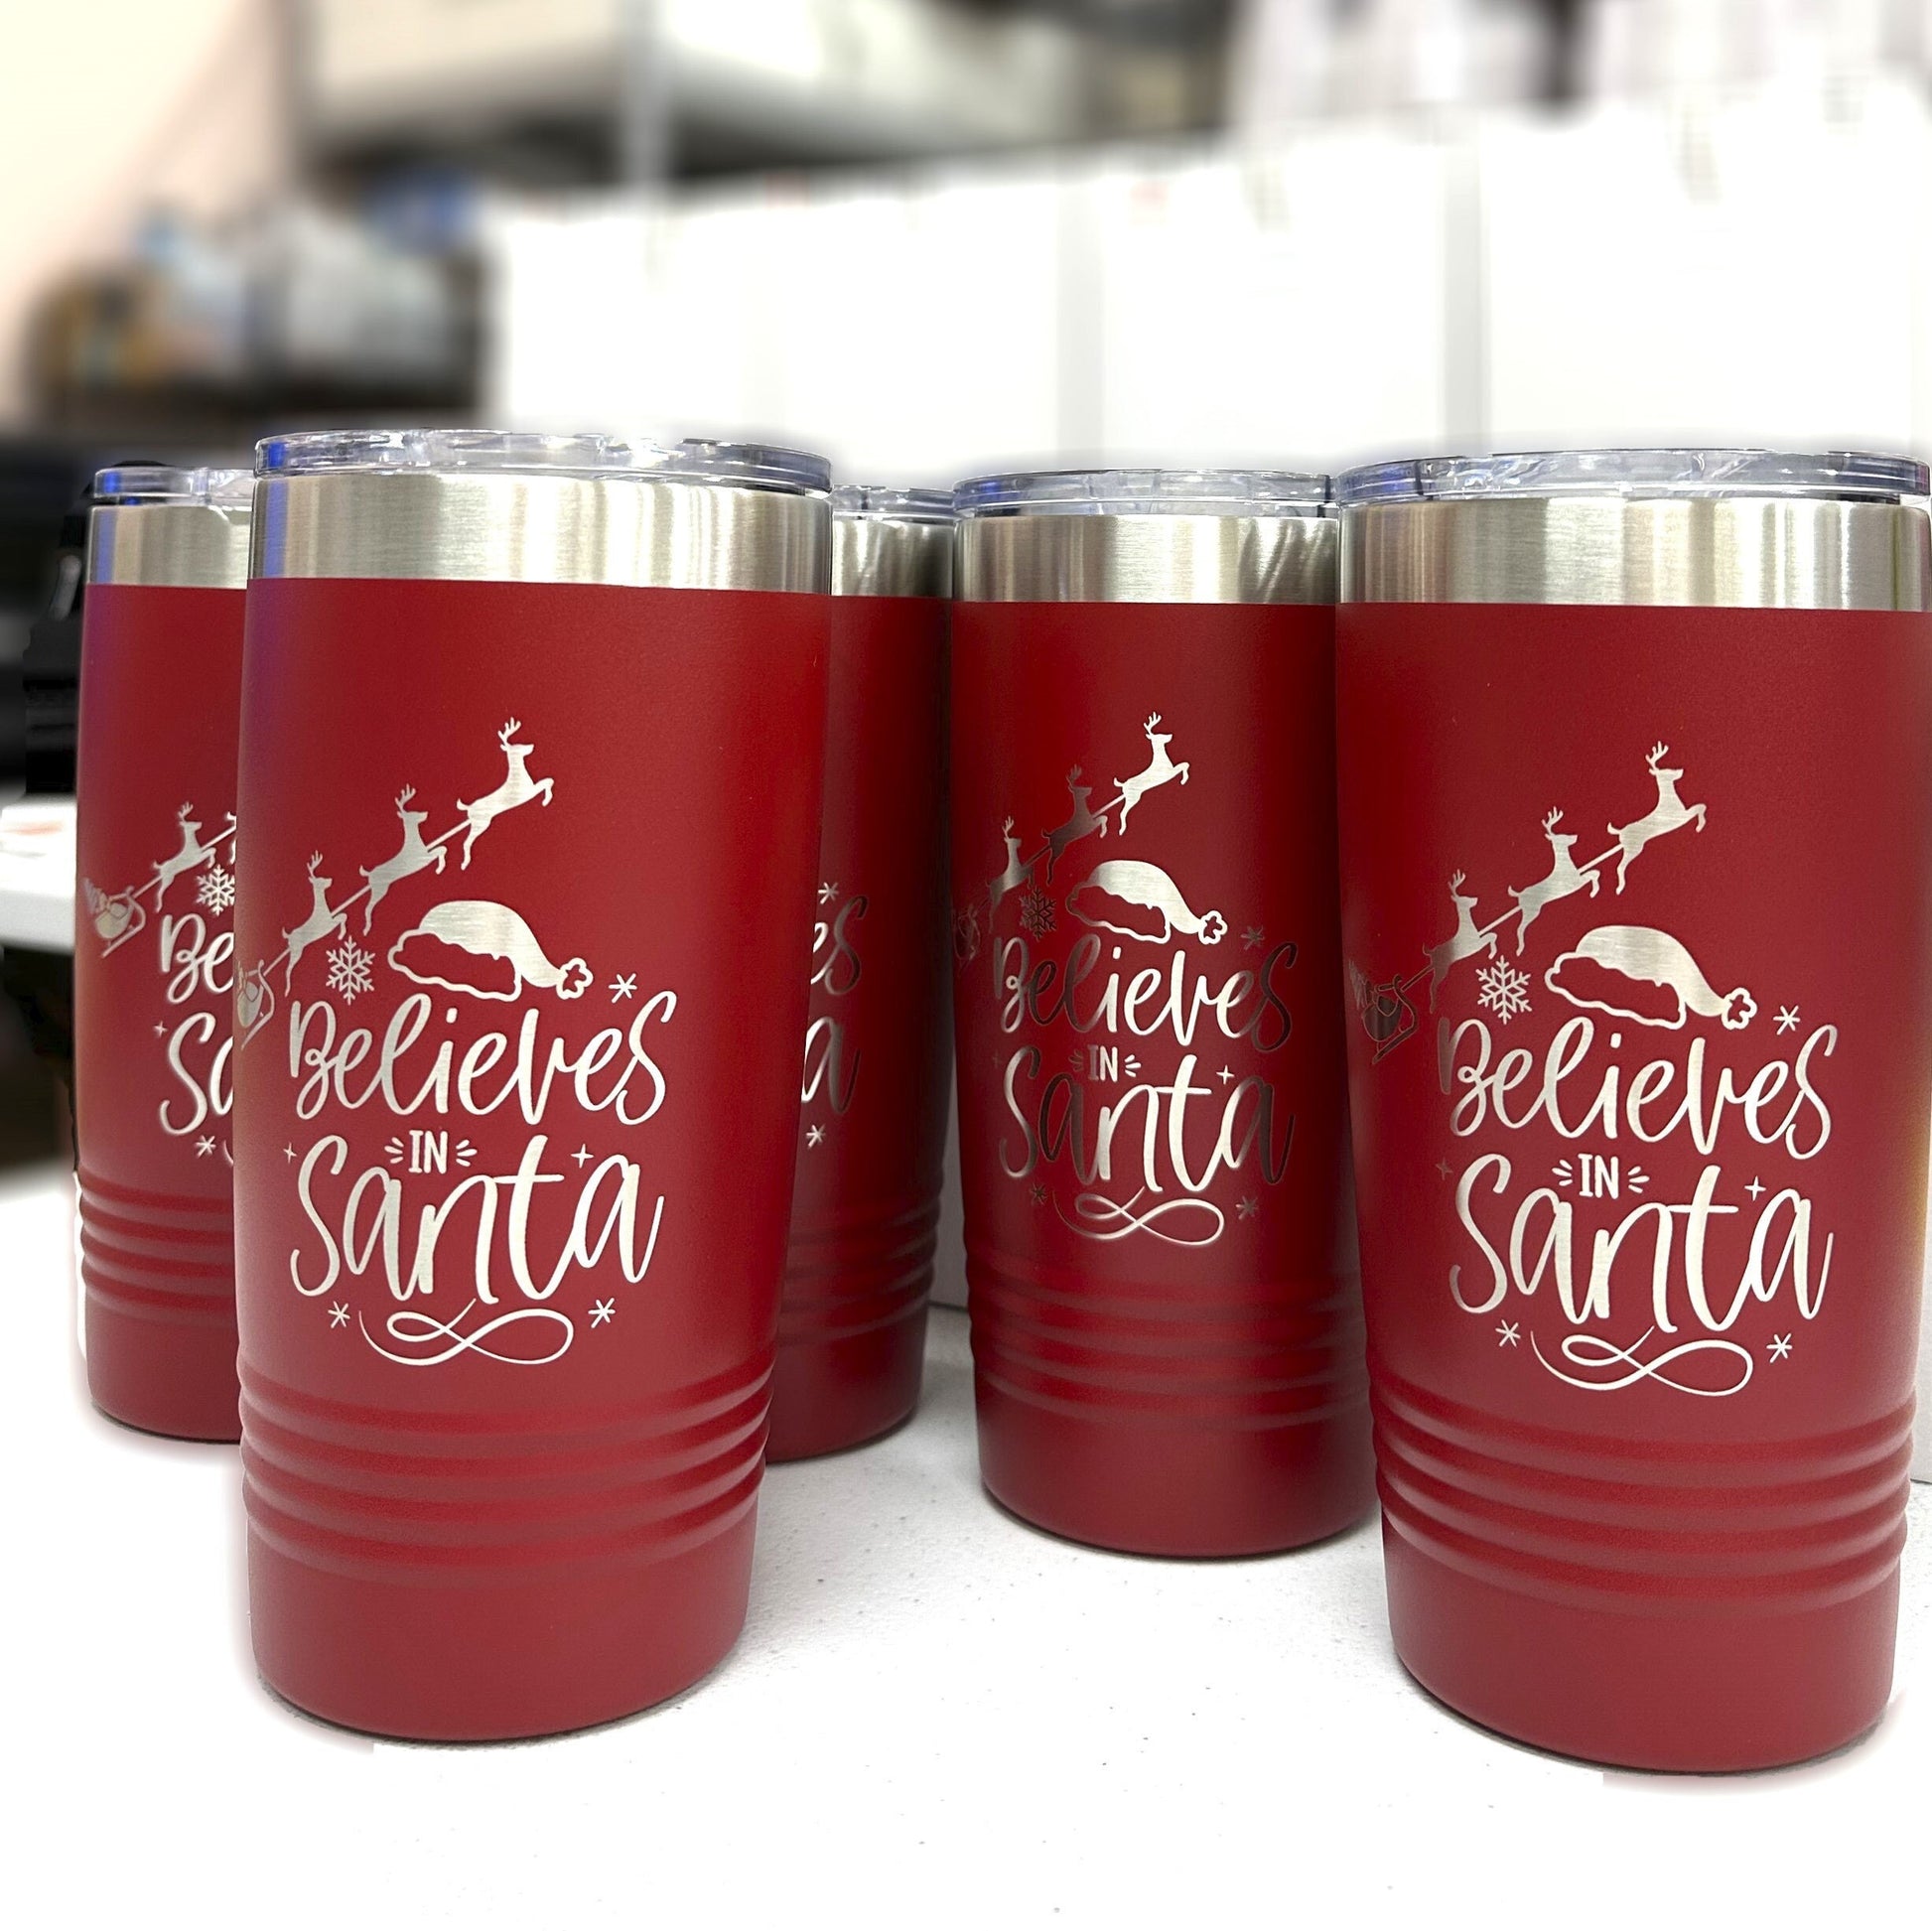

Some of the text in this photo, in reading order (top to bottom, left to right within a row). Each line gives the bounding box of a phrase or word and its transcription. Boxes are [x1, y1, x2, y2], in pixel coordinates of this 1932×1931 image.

[290, 991, 677, 1125] Believes
[994, 933, 1298, 1052] Believes
[999, 1045, 1296, 1192] Santa
[1088, 1044, 1119, 1082] IN
[1438, 1016, 1838, 1160] Believes
[408, 1130, 448, 1173] IN
[1578, 1153, 1619, 1199] IN
[290, 1134, 665, 1304] Santa
[1449, 1153, 1834, 1333] Santa
